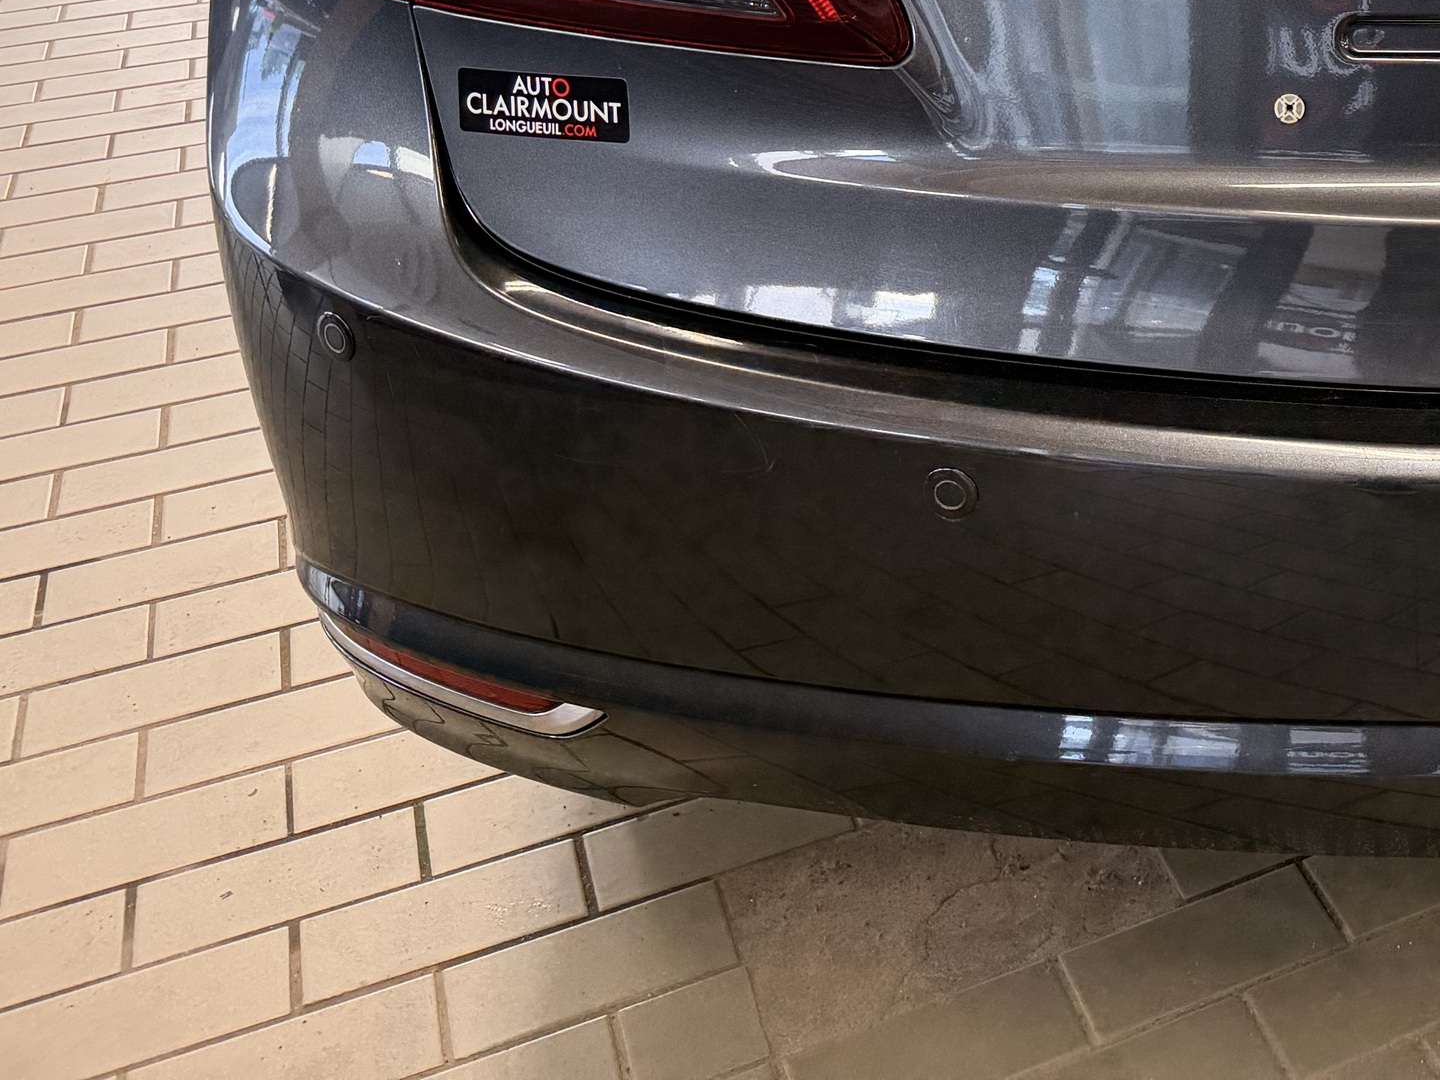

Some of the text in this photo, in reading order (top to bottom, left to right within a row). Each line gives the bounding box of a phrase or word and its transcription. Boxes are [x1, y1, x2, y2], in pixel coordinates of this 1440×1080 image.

[512, 75, 570, 97] AUTO
[466, 92, 622, 124] CLAIRMOUNT
[489, 118, 598, 137] LONGUEUIL.COM
